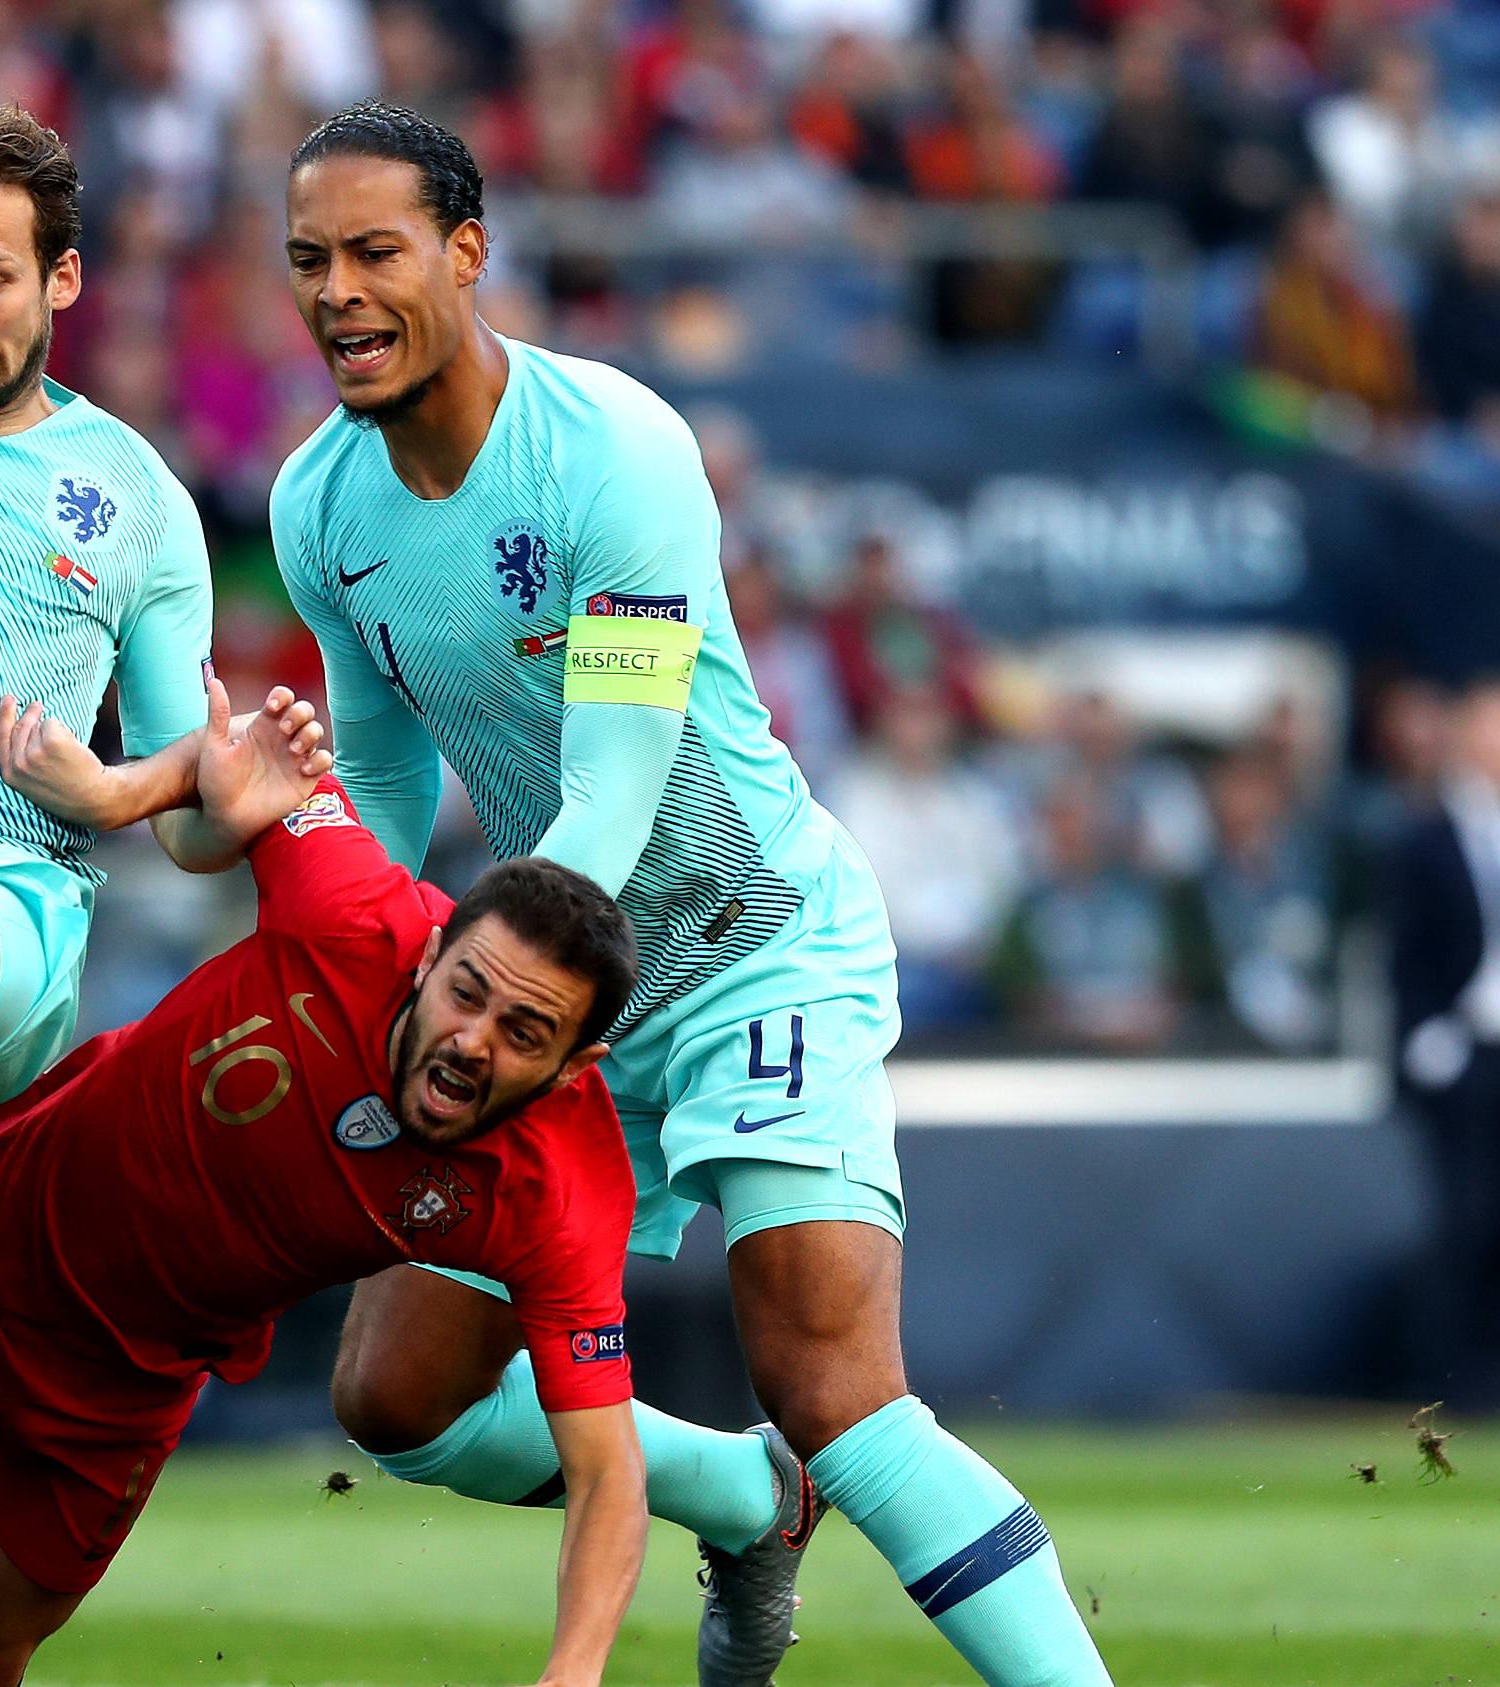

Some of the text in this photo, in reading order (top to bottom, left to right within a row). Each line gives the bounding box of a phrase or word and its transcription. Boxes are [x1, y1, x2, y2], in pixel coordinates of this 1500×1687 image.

[615, 604, 686, 620] RESPECT
[572, 652, 659, 671] RESPECT
[189, 1014, 292, 1125] 10
[748, 1014, 805, 1098] 4
